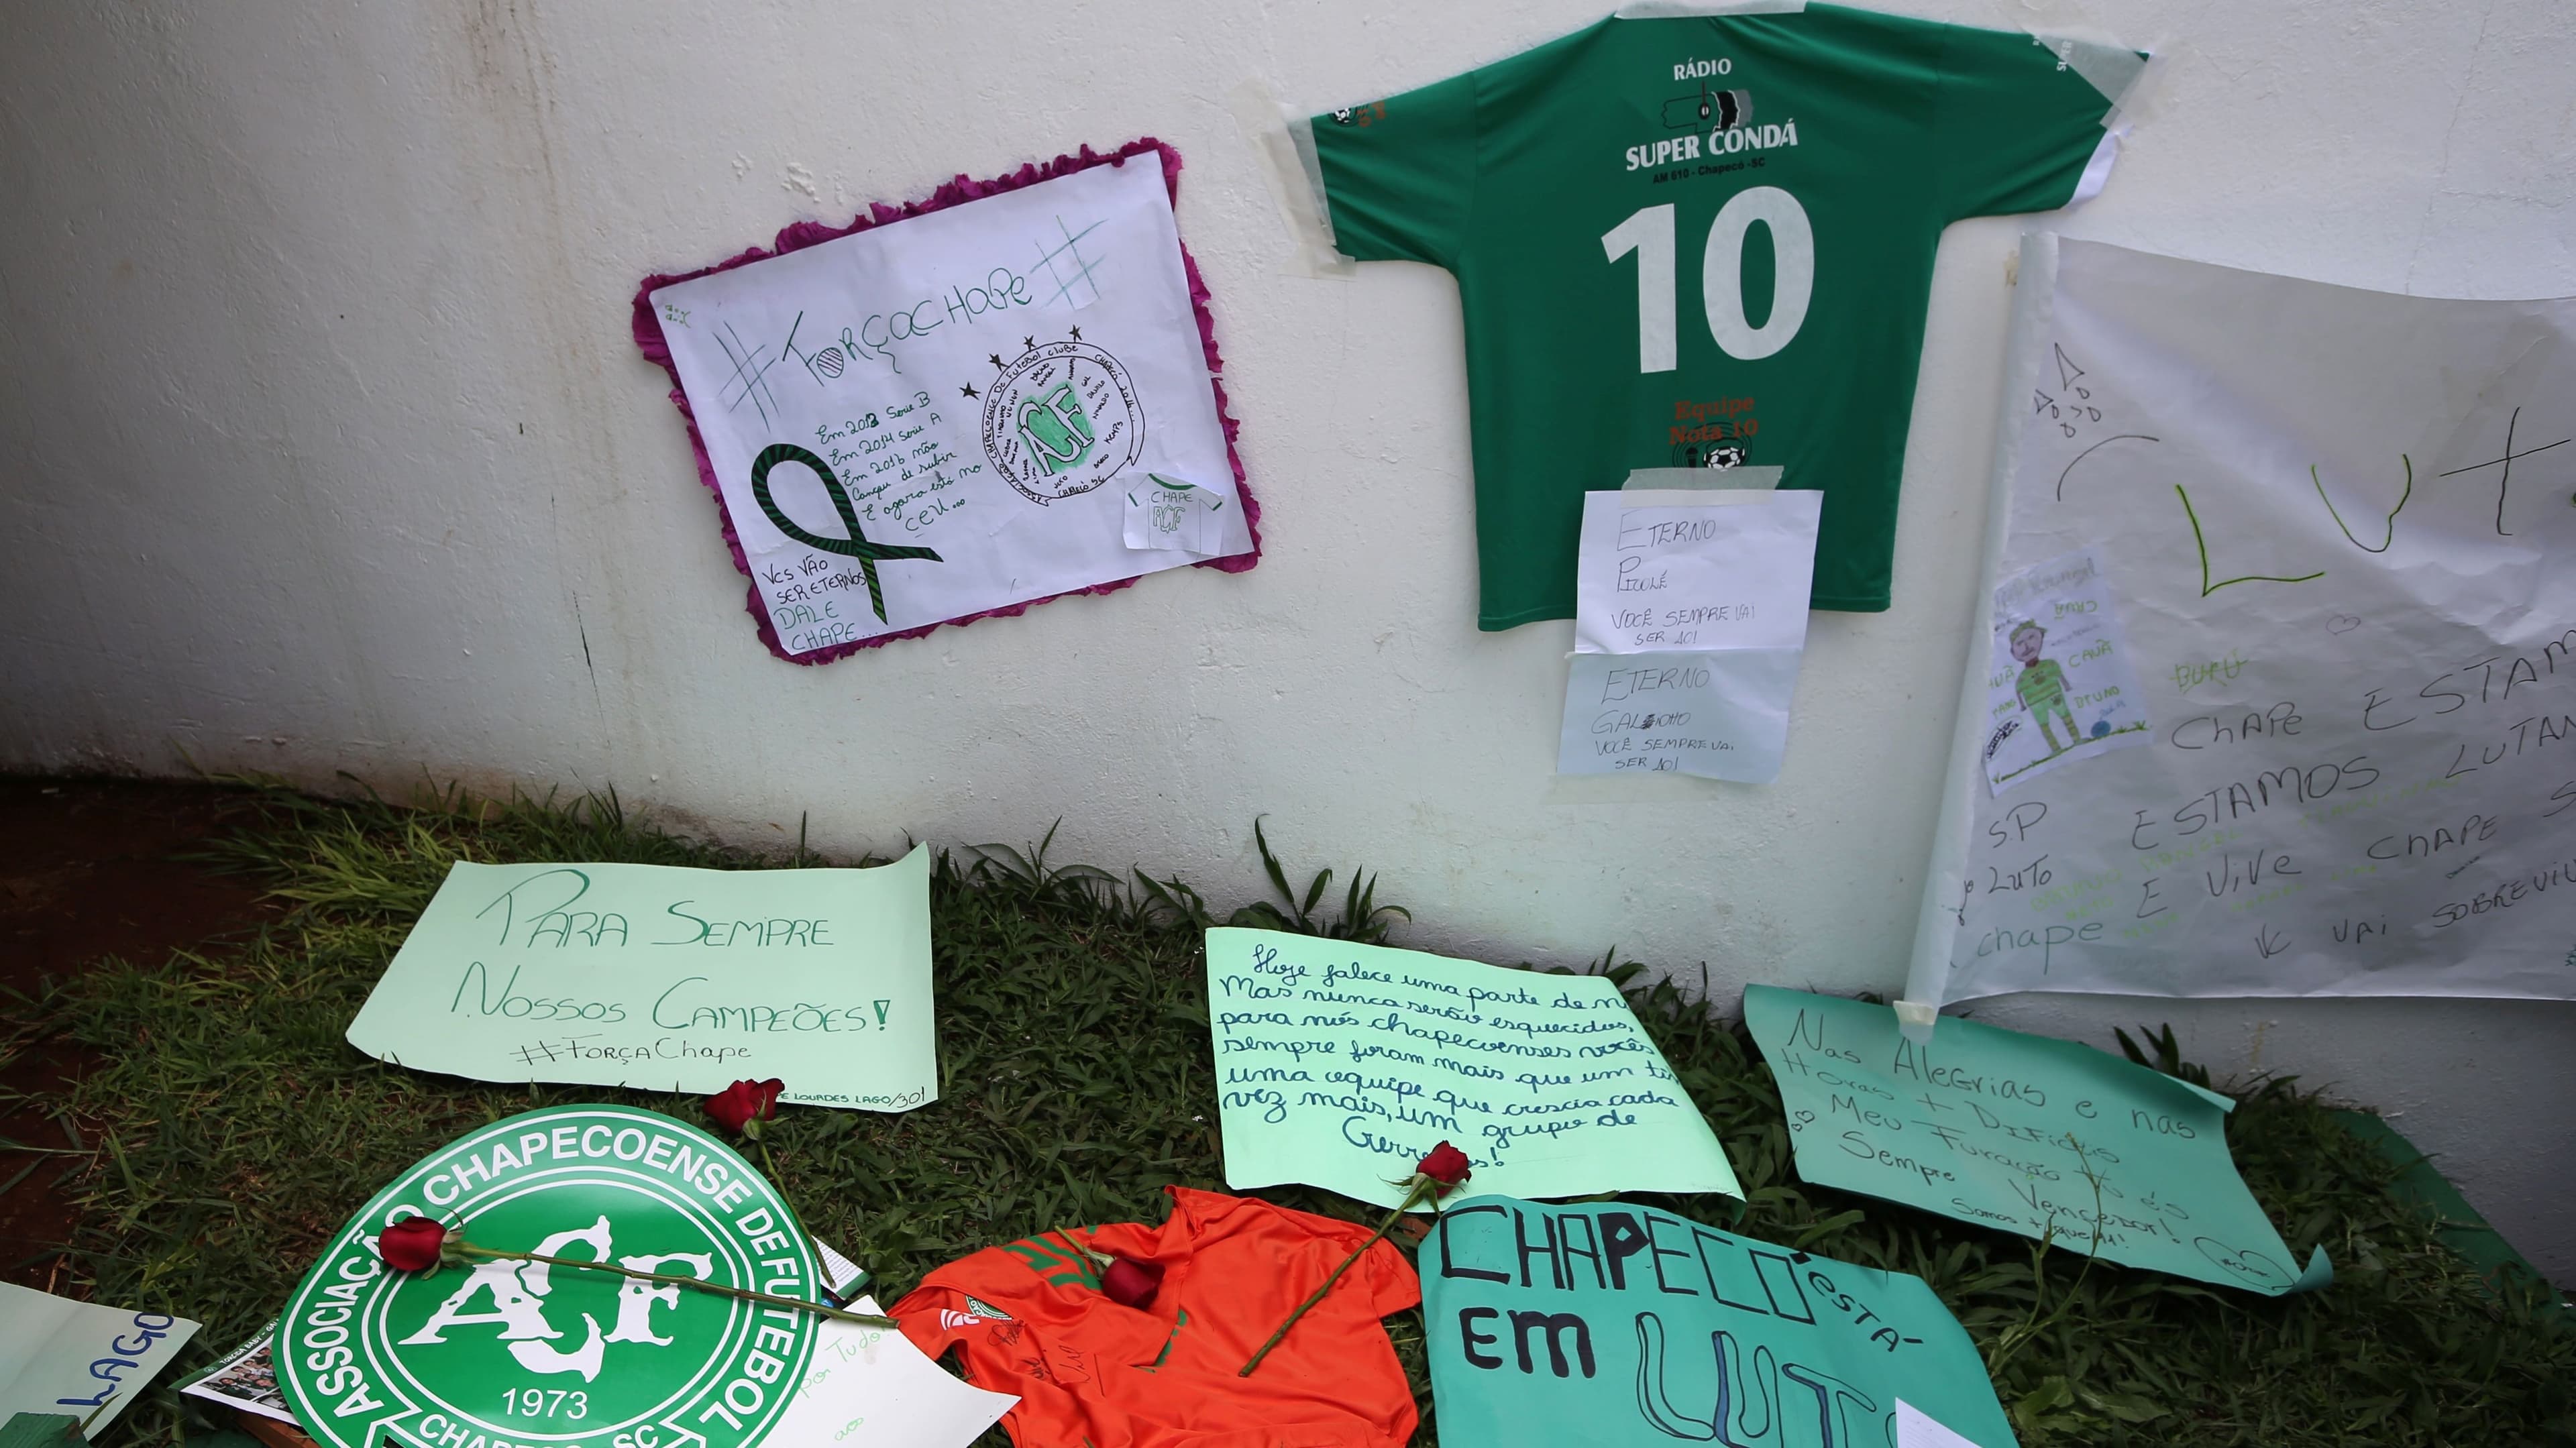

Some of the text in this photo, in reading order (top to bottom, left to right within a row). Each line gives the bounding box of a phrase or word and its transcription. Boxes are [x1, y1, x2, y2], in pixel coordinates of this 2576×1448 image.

[1673, 57, 1732, 81] RÁDIO
[1625, 117, 1799, 172] SUPER CONDÁ
[1653, 171, 1669, 184] AM
[1698, 160, 1744, 177] Chapecó
[1601, 185, 1815, 374] 10
[815, 425, 845, 445] Em
[914, 392, 931, 408] B
[1674, 395, 1755, 422] Equipe
[829, 448, 859, 466] Em
[859, 433, 894, 455] 2014
[930, 412, 942, 425] A
[1668, 419, 1759, 445] Nota 10
[842, 469, 868, 486] Em
[912, 441, 939, 459] não
[901, 452, 958, 481] de subir
[959, 464, 982, 479] no
[1150, 491, 1194, 503] CHAPE
[1616, 509, 1717, 552] ETERNO
[777, 568, 867, 604] SER ETERNOS
[797, 553, 828, 576] VÃO
[773, 601, 839, 630] DALE
[1611, 603, 1756, 629] VOCÊ SEMPRE VAI
[1635, 632, 1665, 646] SER
[1601, 668, 1710, 705] ETERNO
[1595, 737, 1632, 756] VOCÊ
[1641, 738, 1707, 751] SEMPRE
[1615, 757, 1648, 769] SER
[2132, 756, 2380, 850] ESTAMOS
[475, 869, 835, 948] PARA SEMPRE
[2137, 878, 2168, 918] E
[1978, 922, 2103, 975] chape
[451, 961, 892, 1034] NOSSOS CAMPEÕES!
[1219, 975, 1293, 999] Mas
[1302, 988, 1403, 1009] nunca
[1407, 1000, 1485, 1025] serão
[1252, 944, 1588, 1013] Hoje falece uma parte de
[1216, 1011, 1655, 1058] para nós chapecoenses vocês
[1222, 1036, 1336, 1063] sempre
[1349, 1040, 1426, 1066] foram
[1432, 1055, 1505, 1080] mais
[1515, 1072, 1572, 1094] que
[1582, 1066, 1633, 1084] um
[1781, 1049, 1894, 1101] Horas
[1788, 1009, 1862, 1064] Nas
[2076, 1101, 2097, 1119] e
[2132, 1109, 2196, 1139] nas
[794, 1093, 850, 1103] LOURDES
[1224, 1066, 1680, 1117] uma equipe que crescia cada
[1831, 1094, 1902, 1131] Meu
[1223, 1088, 1638, 1150] vez mais, um grupo de
[423, 1125, 753, 1214] CHAPECOENSE
[1839, 1131, 1955, 1186] Sempre
[735, 1207, 790, 1258] DE
[1951, 1197, 2018, 1225] Somos
[1440, 1205, 1817, 1326] CHAPECÓ
[56, 1311, 175, 1406] LAGO
[219, 1347, 246, 1366] TORCIDA
[244, 1334, 263, 1351] BABY
[698, 1256, 801, 1432] FUTEBOL
[1635, 1311, 1896, 1448] LUT
[502, 1388, 588, 1421] 1973
